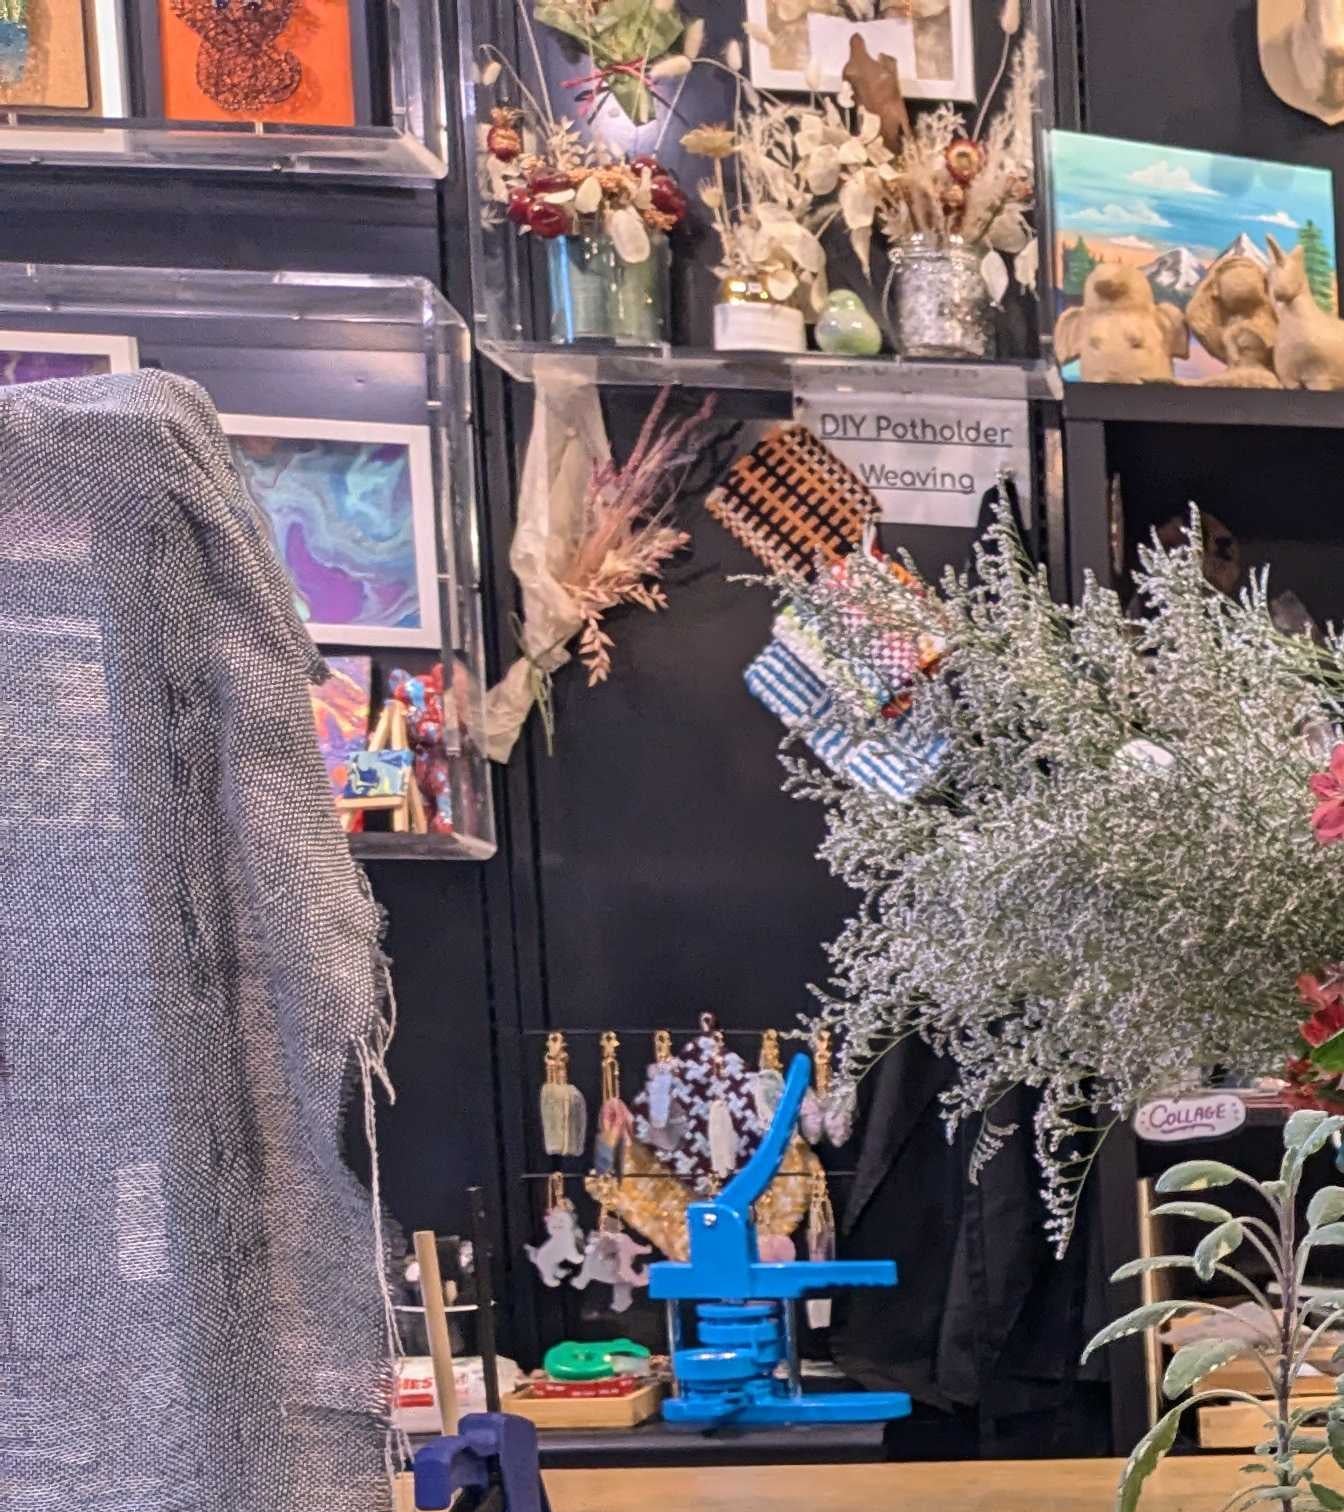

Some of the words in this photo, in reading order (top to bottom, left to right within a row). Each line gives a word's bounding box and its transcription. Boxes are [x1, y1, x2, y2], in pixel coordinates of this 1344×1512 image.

[820, 413, 866, 437] DIY
[876, 415, 1012, 445] Potholder
[860, 463, 975, 495] Weaving
[1149, 1103, 1227, 1129] COLLAGE
